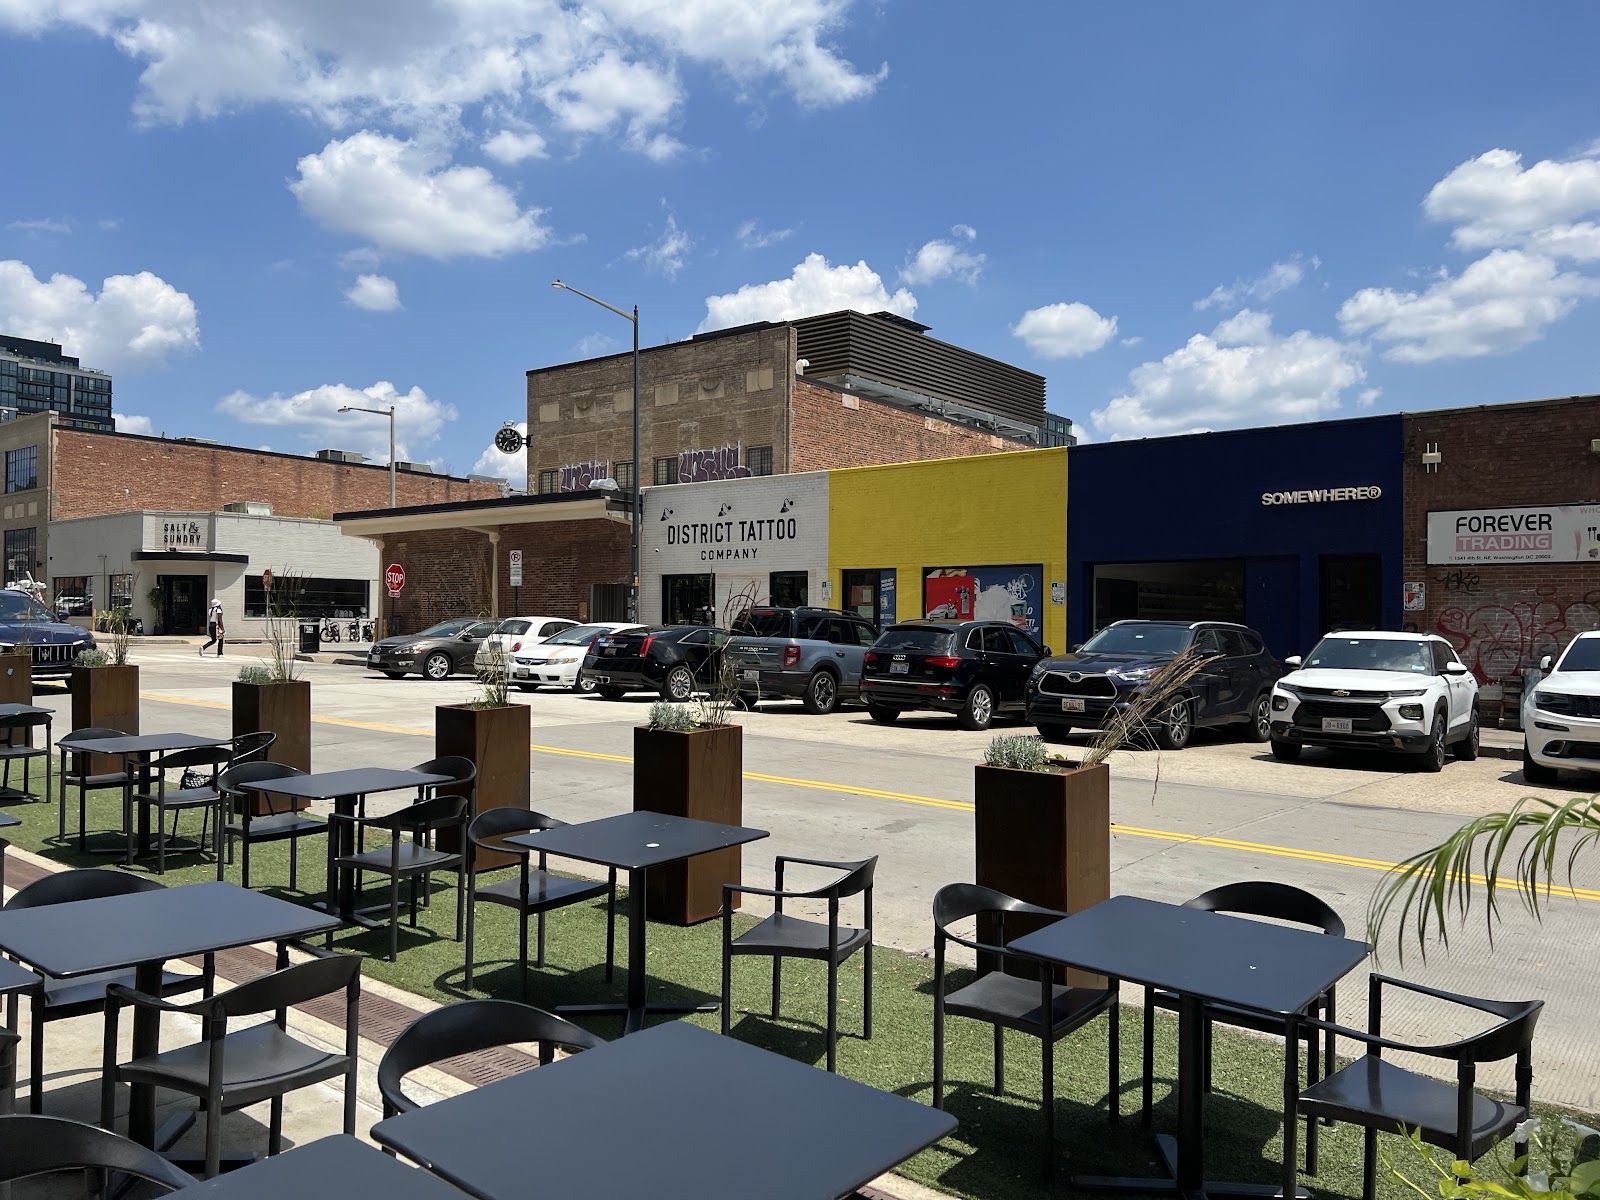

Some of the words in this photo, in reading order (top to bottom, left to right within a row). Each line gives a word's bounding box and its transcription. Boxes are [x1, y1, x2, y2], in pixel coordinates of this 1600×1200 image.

[164, 523, 187, 532] SALT
[1456, 513, 1552, 533] FOREVER
[668, 522, 733, 545] DISTRICT
[739, 518, 796, 542] TATTOO
[163, 534, 201, 544] SUNDRY
[1459, 534, 1549, 550] TRADING
[701, 548, 758, 560] COMPANY
[387, 571, 405, 584] STOP
